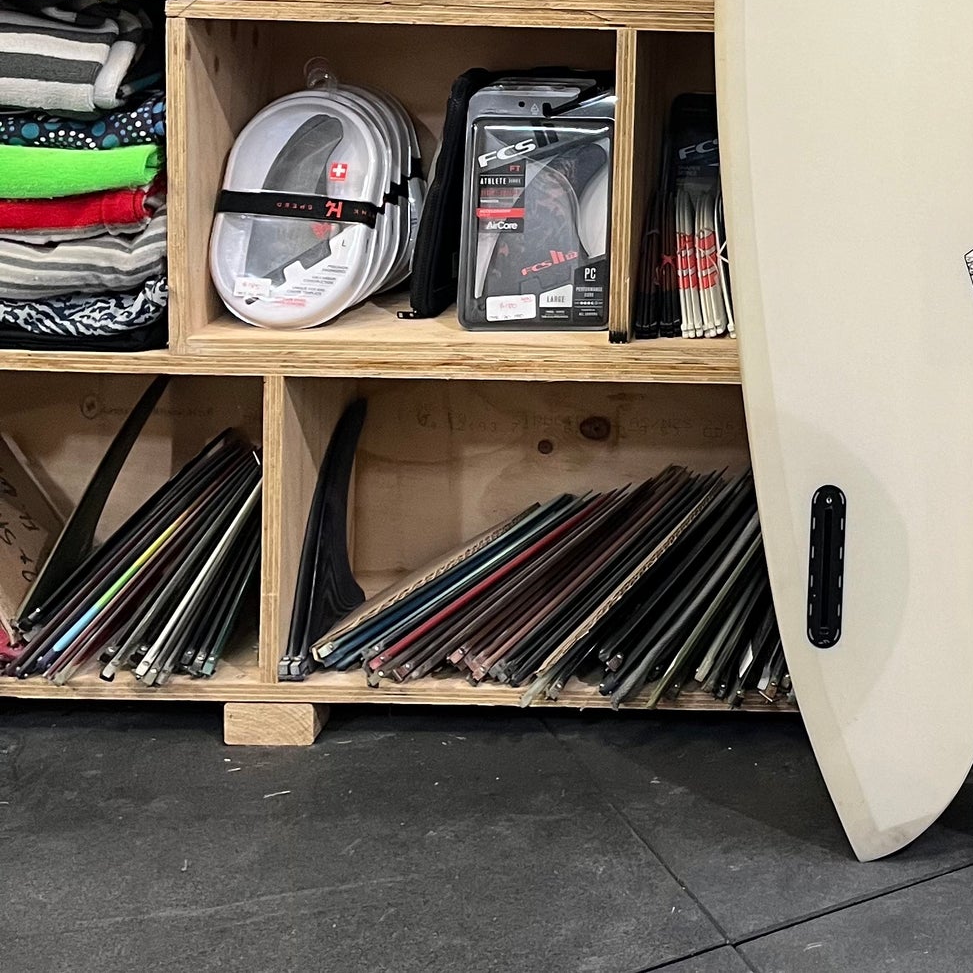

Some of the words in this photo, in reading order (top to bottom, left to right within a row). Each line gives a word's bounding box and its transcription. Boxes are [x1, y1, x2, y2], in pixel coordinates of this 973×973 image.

[478, 138, 537, 168] FCS
[479, 177, 507, 185] ATHLETE
[485, 220, 519, 230] AirCore
[584, 267, 597, 280] PC
[546, 295, 565, 303] LARGE
